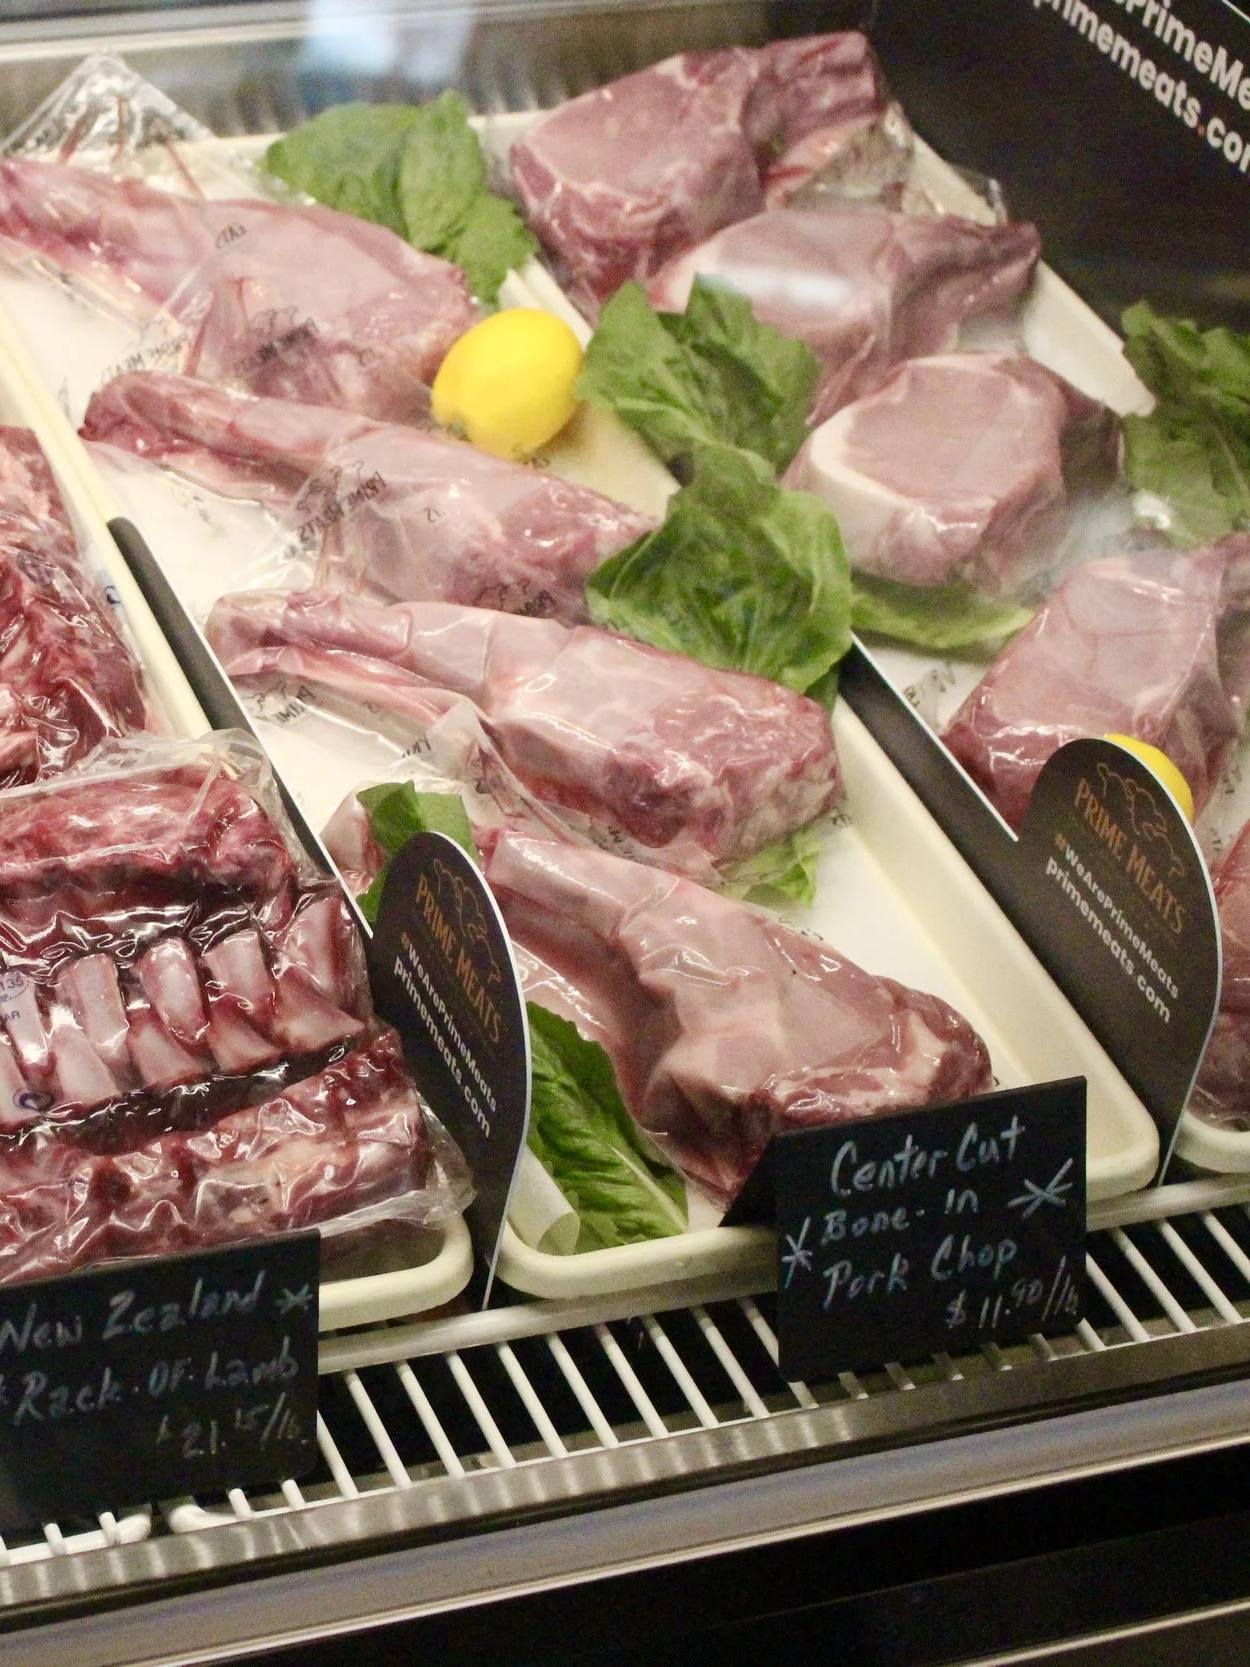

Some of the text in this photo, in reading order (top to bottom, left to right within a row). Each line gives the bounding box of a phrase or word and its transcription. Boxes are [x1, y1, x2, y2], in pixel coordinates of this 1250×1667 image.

[1033, 0, 1250, 173] imemeats.co
[1054, 833, 1180, 1000] #WeArePrimeMeats
[1074, 778, 1186, 935] PRIME MEATS
[415, 872, 501, 1045] PRIME MEATS
[1045, 857, 1171, 1024] primemeats.com
[401, 932, 497, 1113] #WeArePrimeMeats
[831, 1114, 1025, 1197] Center Cut
[101, 1269, 266, 1341] Zealand
[824, 1233, 1018, 1310] Pork Chop
[14, 1366, 123, 1427] Rack
[205, 1335, 300, 1391] Lamb
